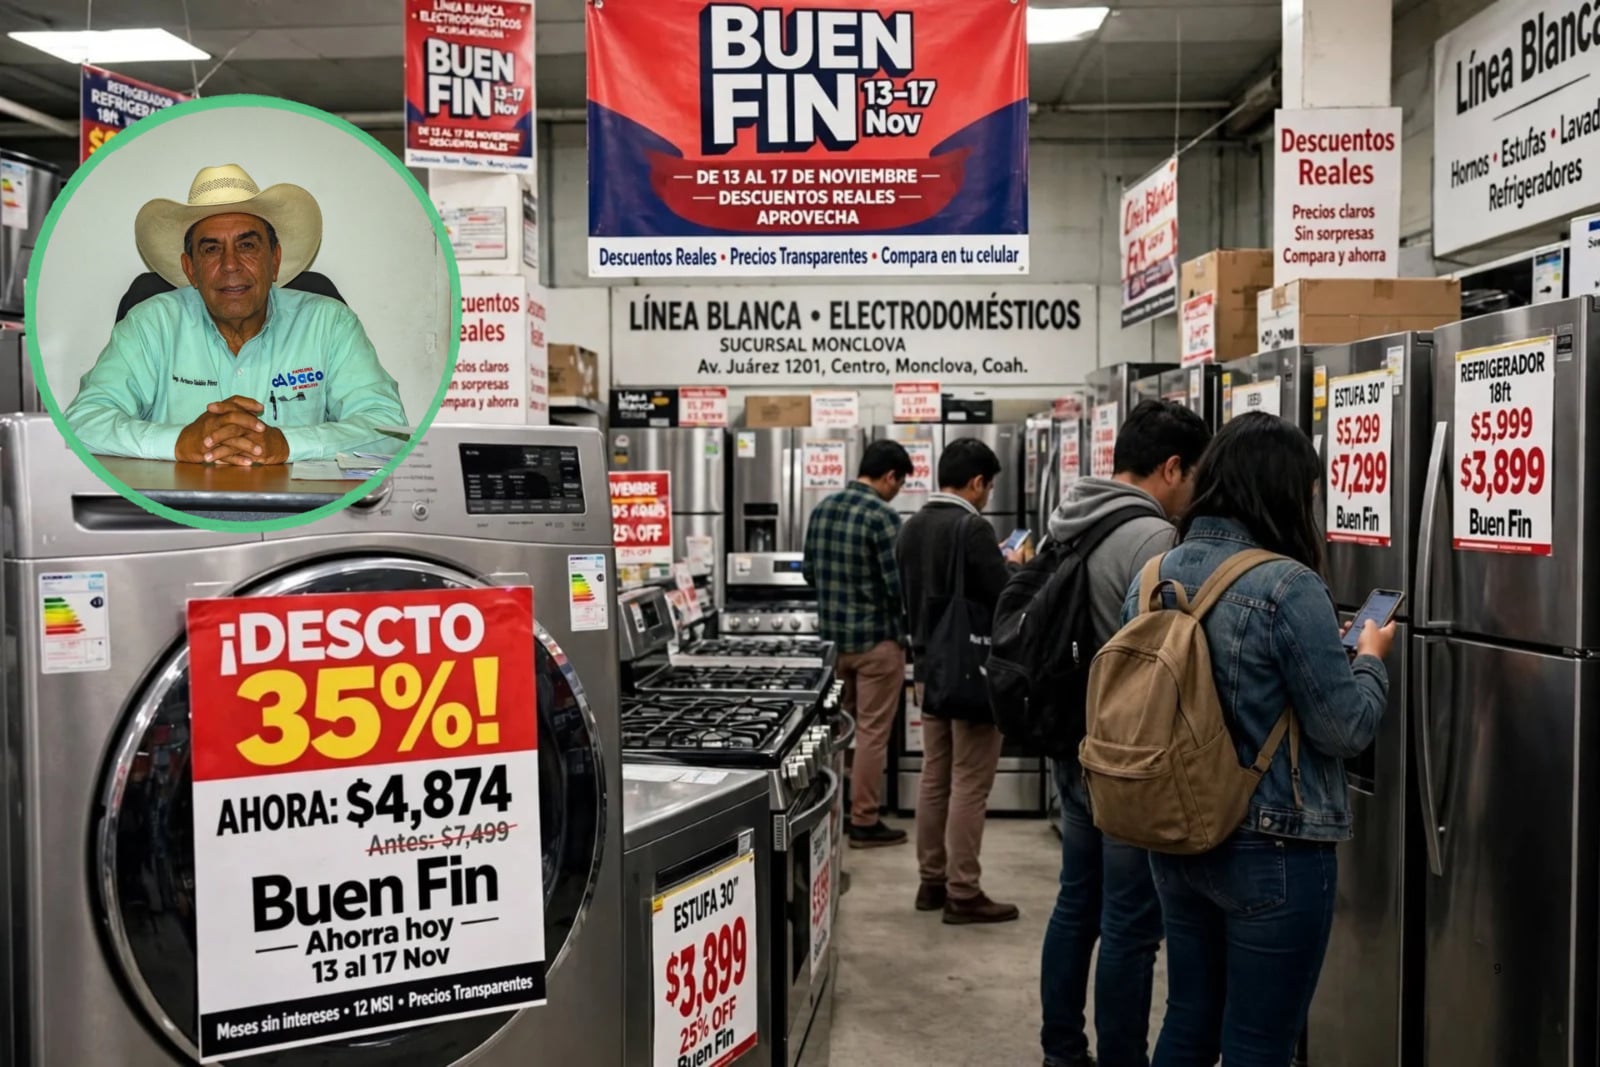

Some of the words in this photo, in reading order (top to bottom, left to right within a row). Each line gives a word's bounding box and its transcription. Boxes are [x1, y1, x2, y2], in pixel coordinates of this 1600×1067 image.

[711, 5, 912, 69] BUEN
[427, 37, 514, 82] BUEN
[428, 75, 491, 116] FIN
[1456, 49, 1513, 116] Línea
[494, 101, 518, 115] Nov
[712, 73, 857, 144] FIN
[865, 109, 921, 135] Nov
[1281, 128, 1395, 153] Descuentos
[1451, 154, 1490, 188] Hornos
[1501, 126, 1546, 168] Estufas
[696, 170, 719, 184] DE
[722, 170, 740, 184] 13
[743, 170, 766, 184] AL
[770, 170, 788, 184] 17
[792, 170, 814, 184] DE
[818, 169, 918, 184] NOVIEMBRE
[1299, 158, 1375, 185] Reales
[1489, 157, 1583, 211] Refrigeradores
[718, 190, 828, 205] DESCUENTOS
[832, 190, 896, 204] REALES
[1292, 204, 1335, 219] Precios
[1339, 203, 1375, 219] claros
[756, 210, 860, 225] APROVECHA
[1295, 225, 1314, 241] Sin
[1316, 227, 1374, 244] sorpresas
[599, 248, 672, 266] Descuentos
[675, 248, 717, 265] Reales
[730, 248, 778, 265] Precios
[779, 248, 868, 269] Transparentes
[881, 248, 938, 268] Compara
[941, 253, 958, 264] en
[960, 249, 974, 264] tu
[976, 245, 1020, 264] celular
[1283, 247, 1335, 266] Compara
[1338, 251, 1347, 266] y
[1348, 246, 1386, 262] ahorra
[629, 294, 699, 330] LÍNEA
[706, 301, 801, 330] BLANCA
[829, 293, 1081, 330] ELECTRODOMÉSTICOS
[720, 337, 807, 352] SUCURSAL
[812, 337, 906, 352] MONCLOVA
[479, 359, 509, 373] claros
[697, 359, 721, 374] Av.
[726, 357, 781, 374] Juárez
[785, 359, 826, 376] 1201,
[831, 359, 891, 376] Centro,
[895, 358, 978, 376] Monclova,
[982, 358, 1029, 374] Coah.
[1461, 351, 1545, 382] REFRIGERADOR
[461, 380, 509, 393] sorpresas
[478, 398, 485, 411] y
[487, 394, 519, 408] ahorra
[1335, 385, 1366, 408] ESTUFA
[1367, 382, 1385, 404] 30"
[1489, 381, 1512, 403] 18ft
[1336, 413, 1381, 449] $5,299
[1471, 407, 1533, 445] $5,999
[1331, 451, 1387, 500] $7,299
[1460, 447, 1545, 502] $3,899
[636, 524, 663, 542] OFF
[1336, 505, 1361, 530] Buen
[1363, 506, 1379, 531] Fin
[1469, 508, 1505, 536] Buen
[1508, 509, 1532, 538] Fin
[219, 602, 485, 677] ¡DESCTO
[235, 656, 500, 767] 35%!
[216, 790, 338, 837] AHORA:
[346, 764, 512, 830] $4,874
[368, 833, 435, 857] Antes:
[441, 821, 509, 849] $7,499
[252, 872, 404, 932] Buen
[417, 855, 498, 911] Fin
[674, 888, 718, 933] ESTUFA
[720, 876, 739, 910] 30"
[305, 923, 399, 956] Ahorra
[406, 917, 454, 941] hoy
[312, 959, 338, 983] 13
[345, 955, 366, 978] al
[372, 950, 397, 975] 17
[403, 947, 451, 970] Nov
[665, 916, 747, 1018] $3,899
[216, 1019, 259, 1041] Meses
[261, 1014, 280, 1032] sin
[282, 1007, 341, 1029] intereses
[353, 1001, 369, 1017] 12
[370, 997, 395, 1015] MSI
[408, 990, 452, 1009] Precios
[453, 975, 534, 1003] Transparentes
[680, 1013, 709, 1055] 25%
[712, 995, 737, 1031] OFF
[715, 1028, 735, 1055] Fin
